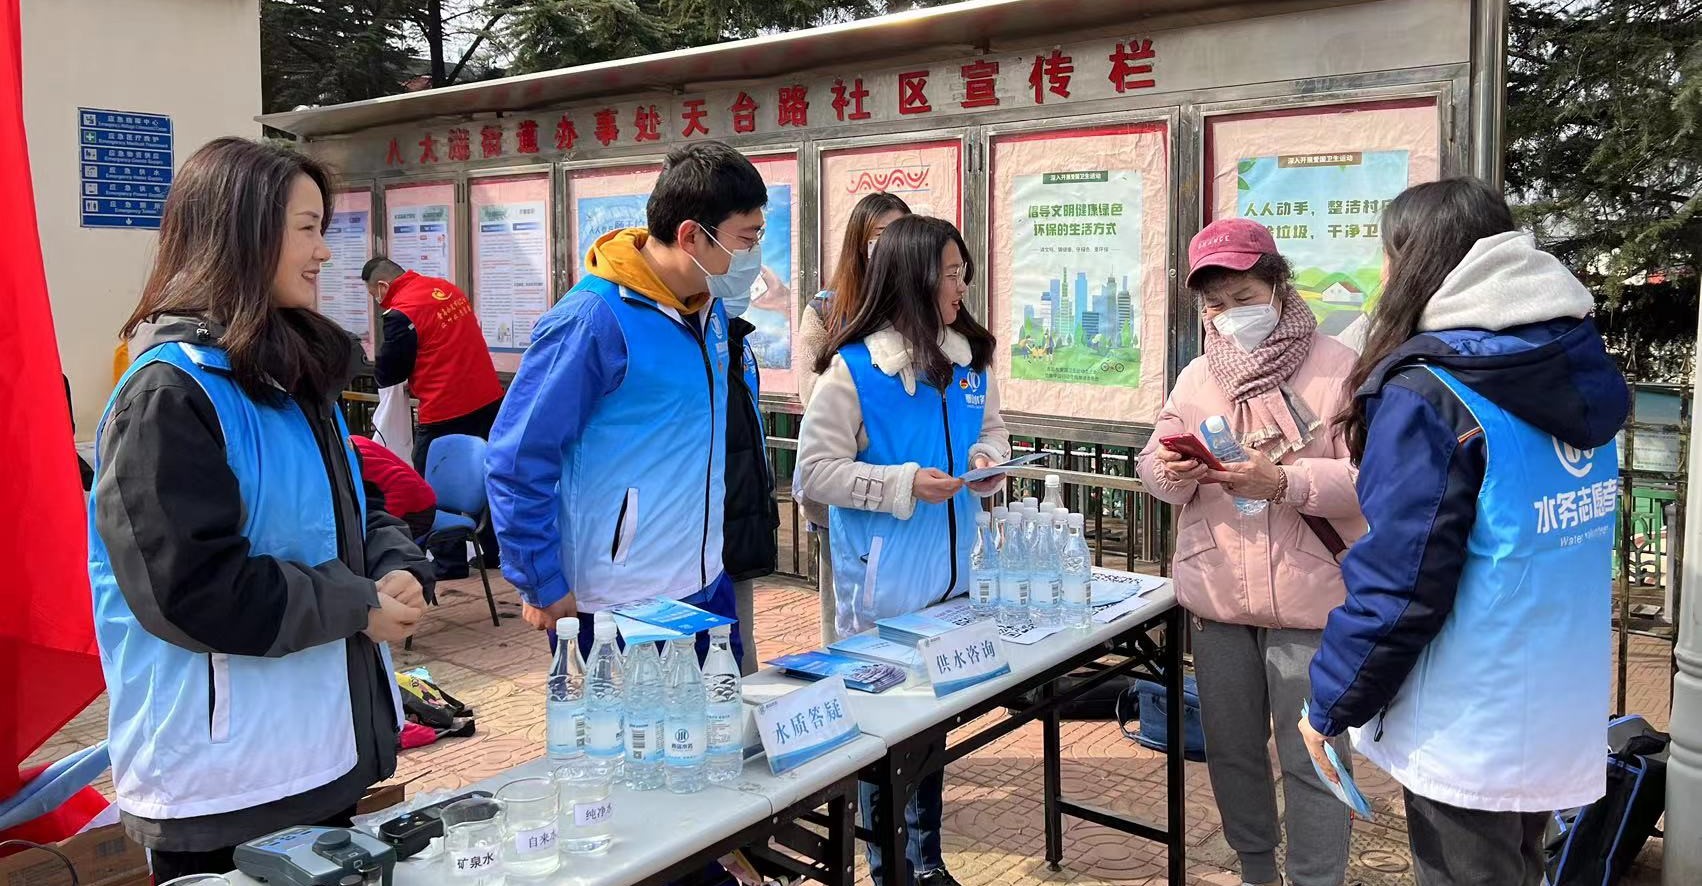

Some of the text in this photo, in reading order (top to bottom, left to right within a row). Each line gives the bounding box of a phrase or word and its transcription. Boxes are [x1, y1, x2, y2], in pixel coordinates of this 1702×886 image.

[1028, 203, 1123, 218] 倡导文明健康绿色
[1034, 222, 1117, 237] 环保的生活方式
[936, 640, 996, 675] 供水咨询
[775, 697, 843, 745] 水质答疑
[457, 851, 495, 870] 矿泉水
